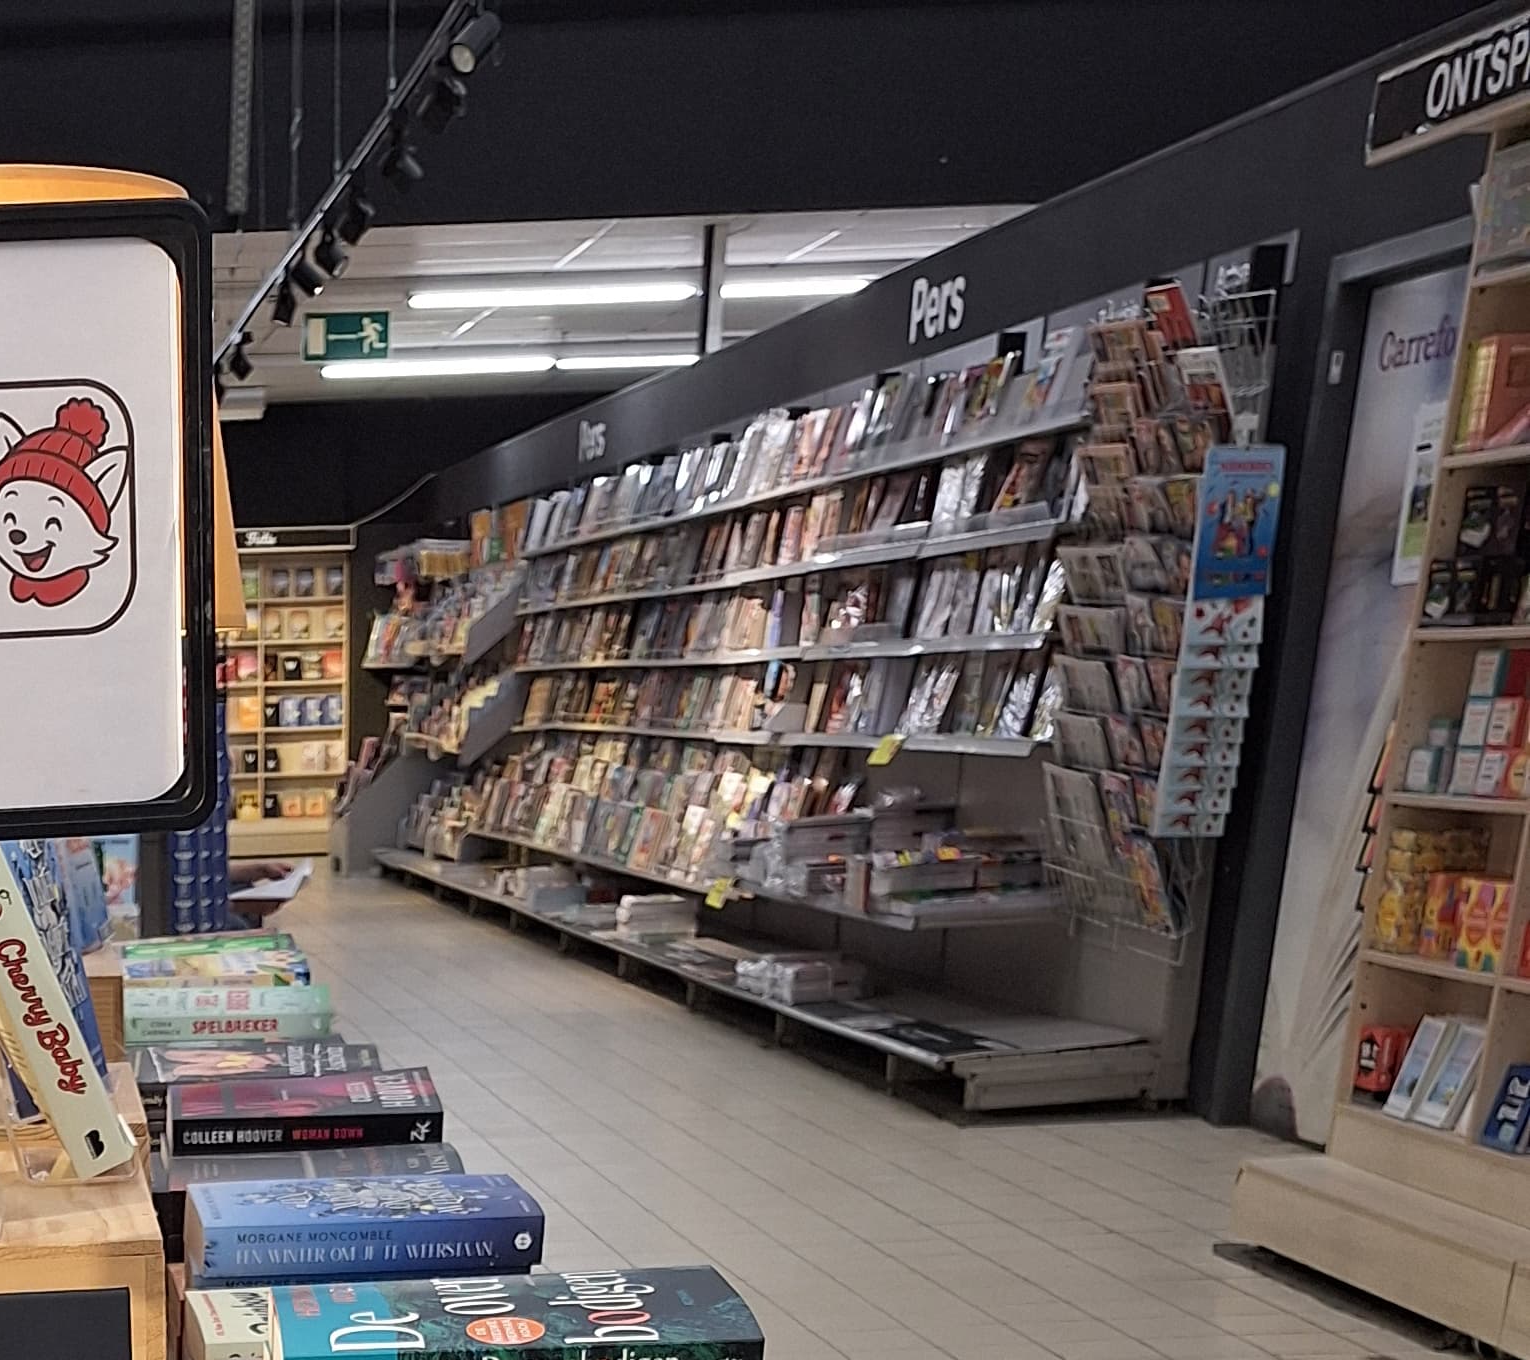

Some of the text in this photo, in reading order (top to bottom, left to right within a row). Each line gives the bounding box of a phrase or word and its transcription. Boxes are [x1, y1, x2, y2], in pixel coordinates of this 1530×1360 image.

[908, 276, 966, 344] Pers
[192, 1019, 278, 1035] SPELBREKER
[37, 1022, 88, 1095] Baby
[183, 1130, 234, 1145] COLLEEN
[237, 1128, 283, 1143] HOOVER
[333, 1127, 364, 1140] DOWN
[237, 1230, 393, 1245] MORGANE MONCOMBLE
[268, 1246, 325, 1264] WINTER
[330, 1246, 357, 1262] OM
[407, 1241, 493, 1259] WEERSTAAN
[329, 1311, 426, 1353] De
